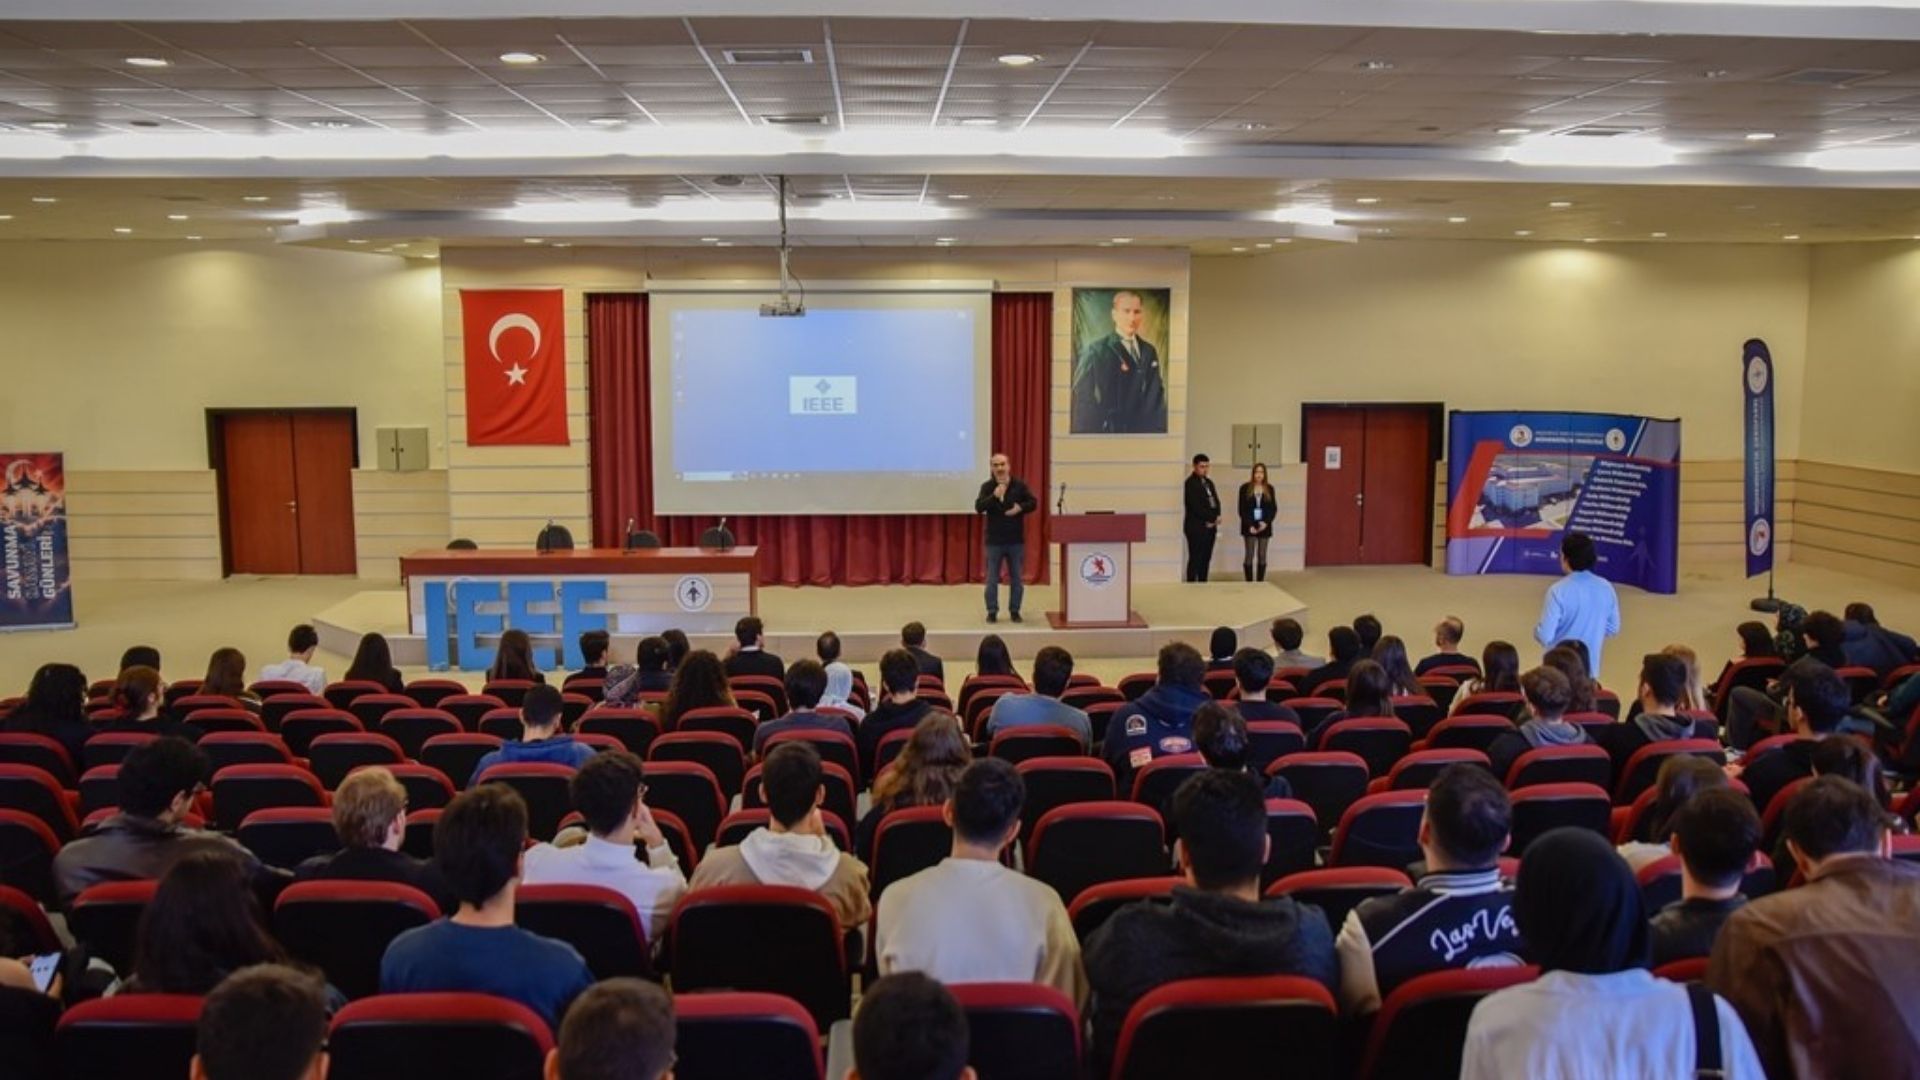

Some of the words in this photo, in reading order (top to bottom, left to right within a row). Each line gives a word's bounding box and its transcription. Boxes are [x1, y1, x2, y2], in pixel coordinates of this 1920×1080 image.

[802, 397, 844, 411] IEEE
[4, 525, 21, 599] SAVUNMA
[36, 536, 56, 598] GÜNLERİ
